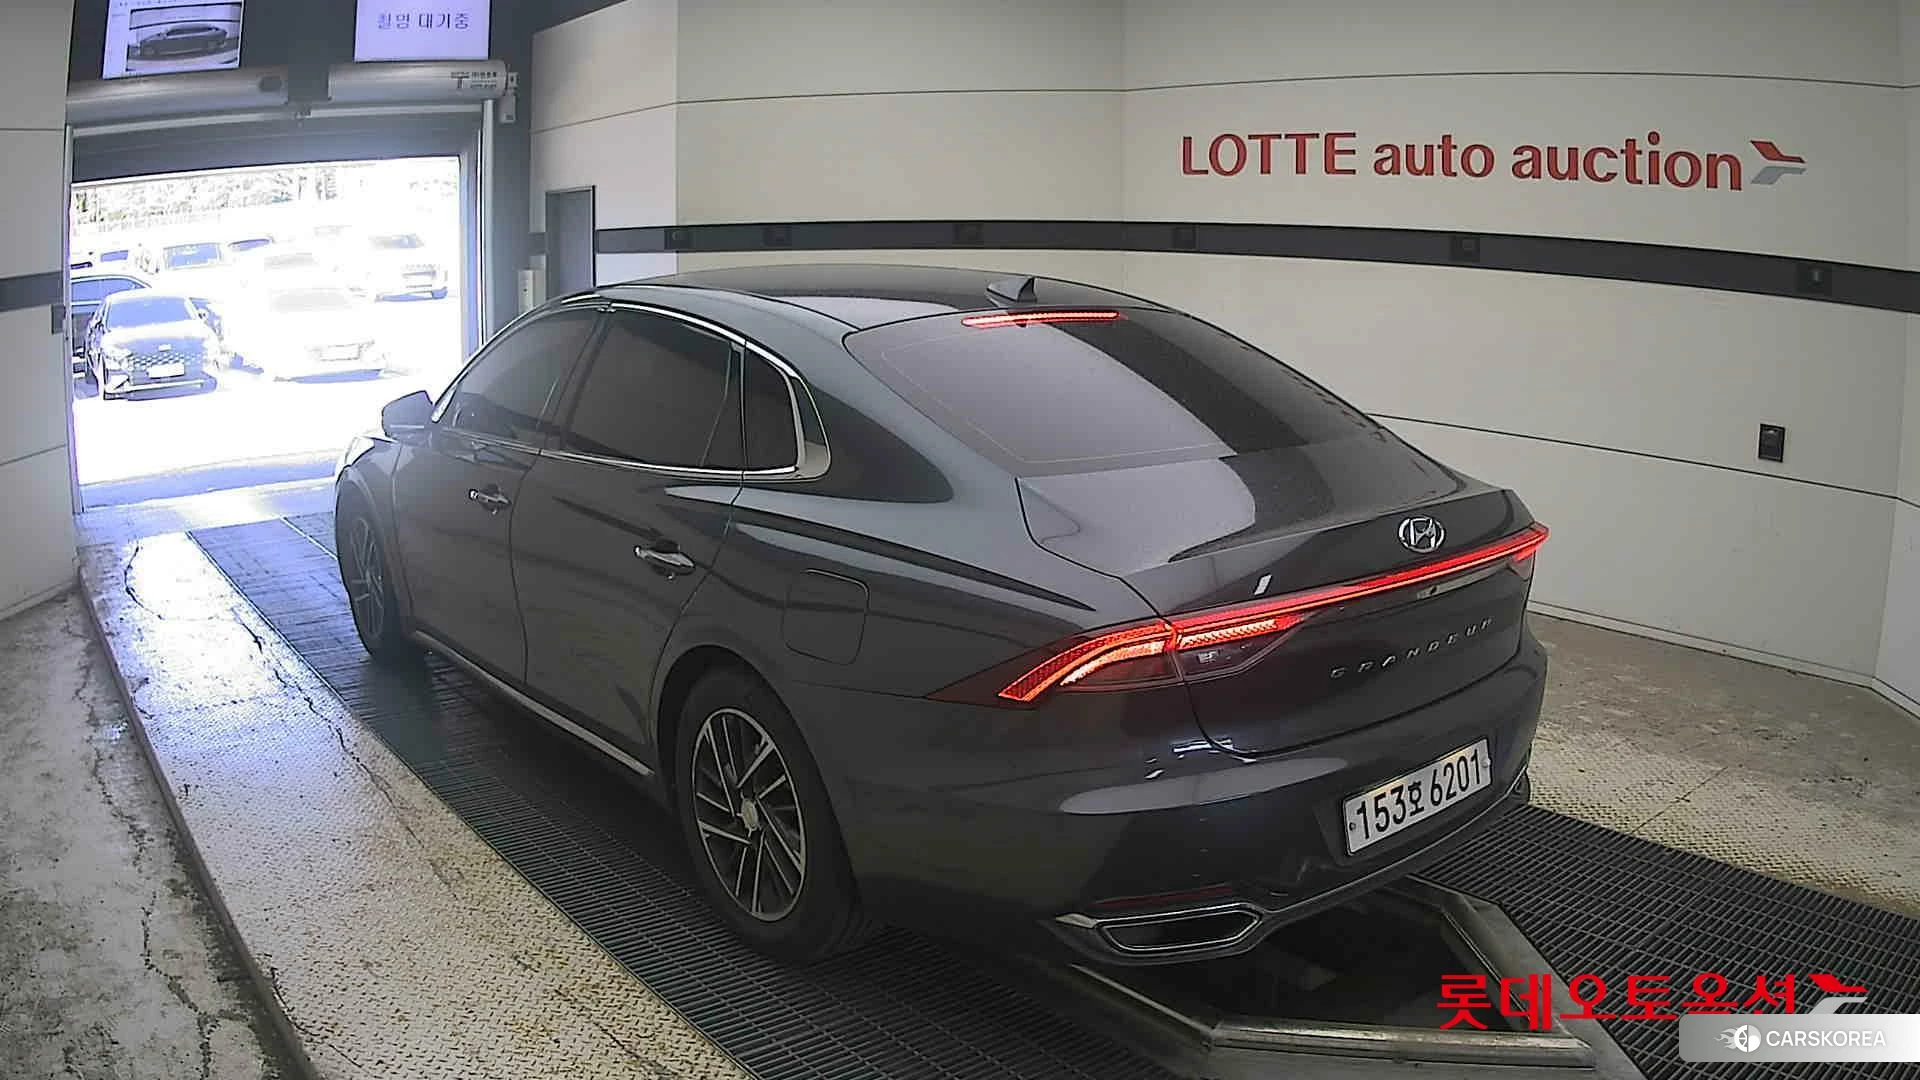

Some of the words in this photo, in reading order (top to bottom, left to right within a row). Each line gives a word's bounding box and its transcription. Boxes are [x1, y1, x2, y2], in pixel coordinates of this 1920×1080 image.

[418, 12, 470, 30] 대기중
[1182, 132, 1356, 177] LOTTE
[1372, 134, 1496, 178] auto
[1511, 131, 1743, 191] auction
[1330, 617, 1494, 678] GRANDEUR
[1356, 781, 1425, 840] 153호
[1430, 748, 1481, 807] 6201
